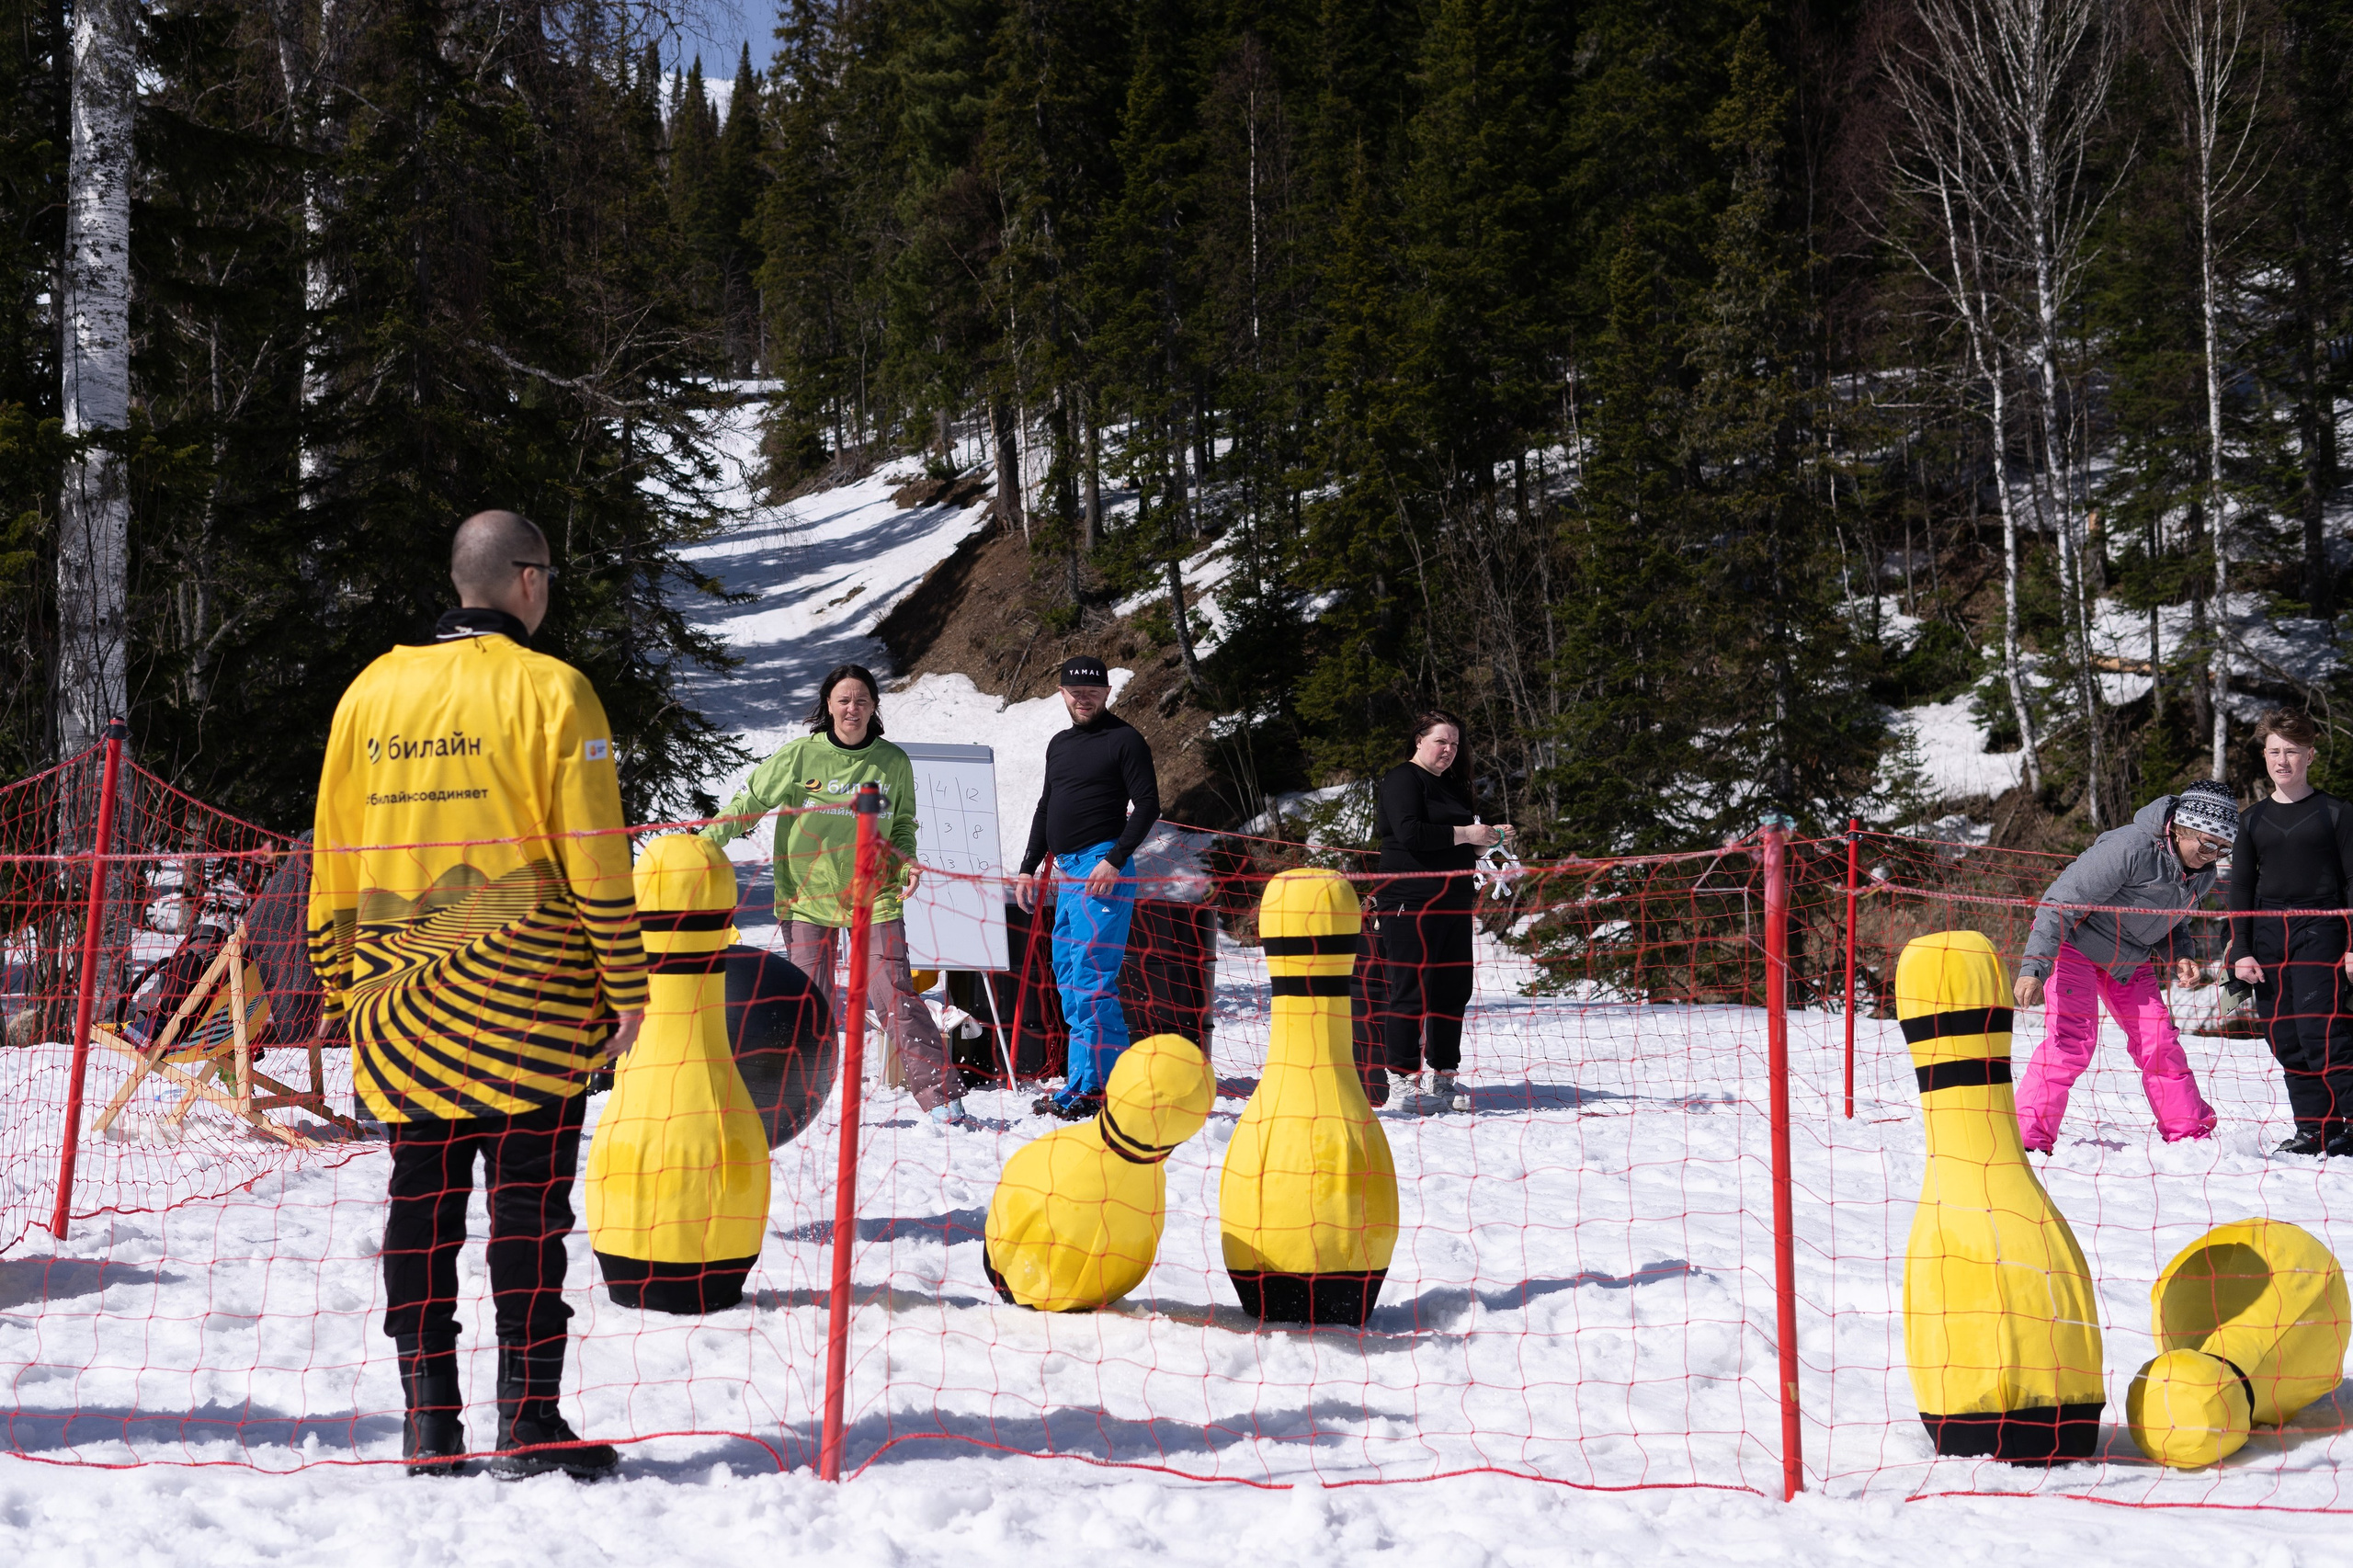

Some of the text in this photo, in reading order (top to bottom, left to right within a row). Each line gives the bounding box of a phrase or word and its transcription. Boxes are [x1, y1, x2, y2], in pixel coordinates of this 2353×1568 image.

[388, 731, 481, 760] билайн
[827, 779, 892, 795] билйн
[936, 780, 948, 800] 4
[966, 788, 980, 802] 12
[944, 823, 953, 834] 3
[972, 824, 983, 839] 8
[947, 859, 956, 869] 3
